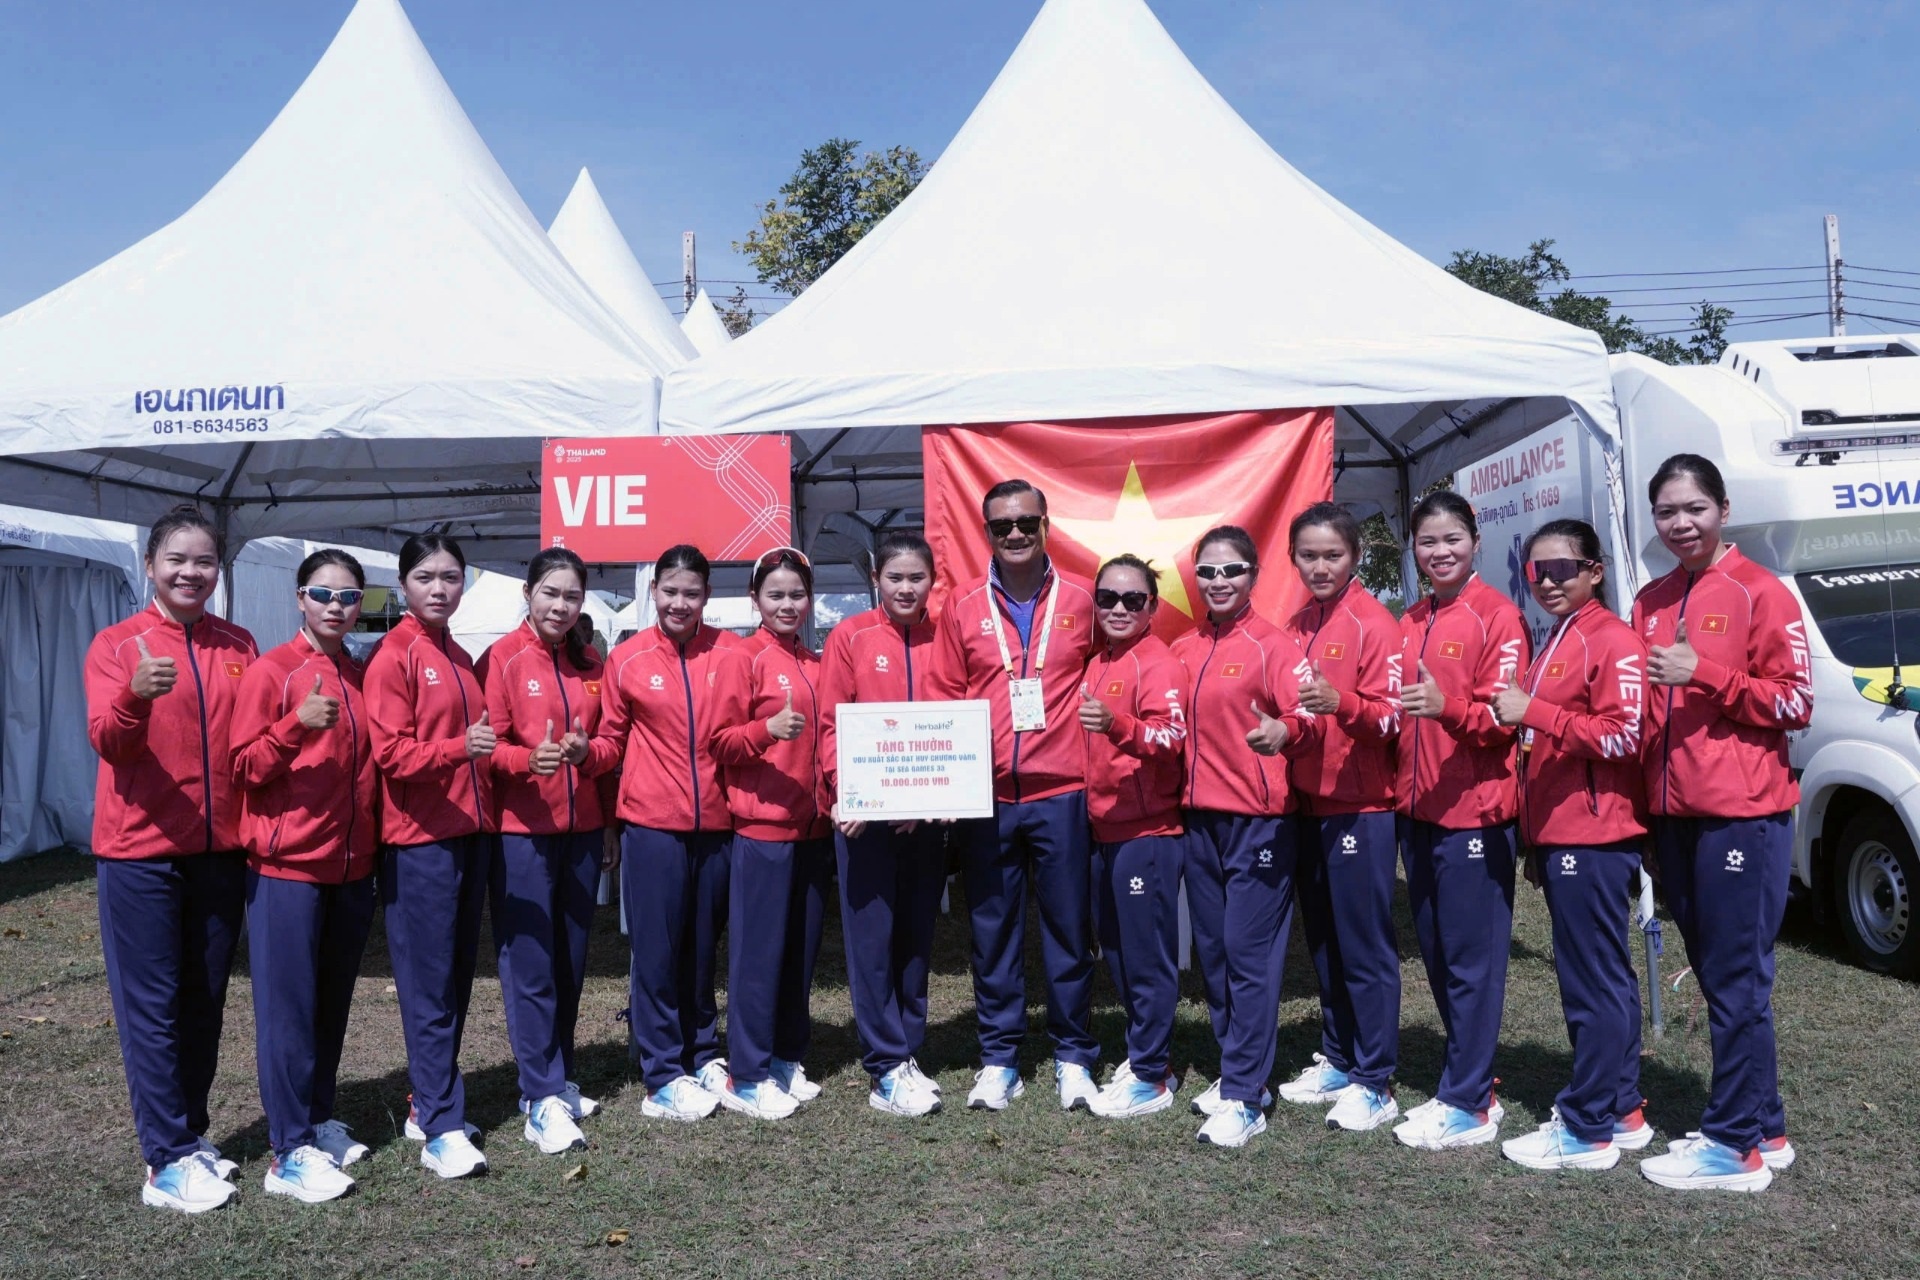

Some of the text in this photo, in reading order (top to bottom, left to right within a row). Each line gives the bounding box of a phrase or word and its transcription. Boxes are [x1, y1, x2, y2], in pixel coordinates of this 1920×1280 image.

[153, 417, 269, 434] 081-6634563
[566, 448, 607, 457] THAILAND
[1470, 437, 1566, 497] AMBULANCE
[553, 474, 647, 528] VIE
[1774, 620, 1814, 720] VIETNAM
[1599, 654, 1642, 758] VIETNAM
[914, 722, 951, 731] Herbalife
[909, 737, 953, 752] THƯỞNG
[897, 765, 910, 773] SEA
[911, 765, 935, 773] GAMES
[880, 777, 930, 787] 10.000.000
